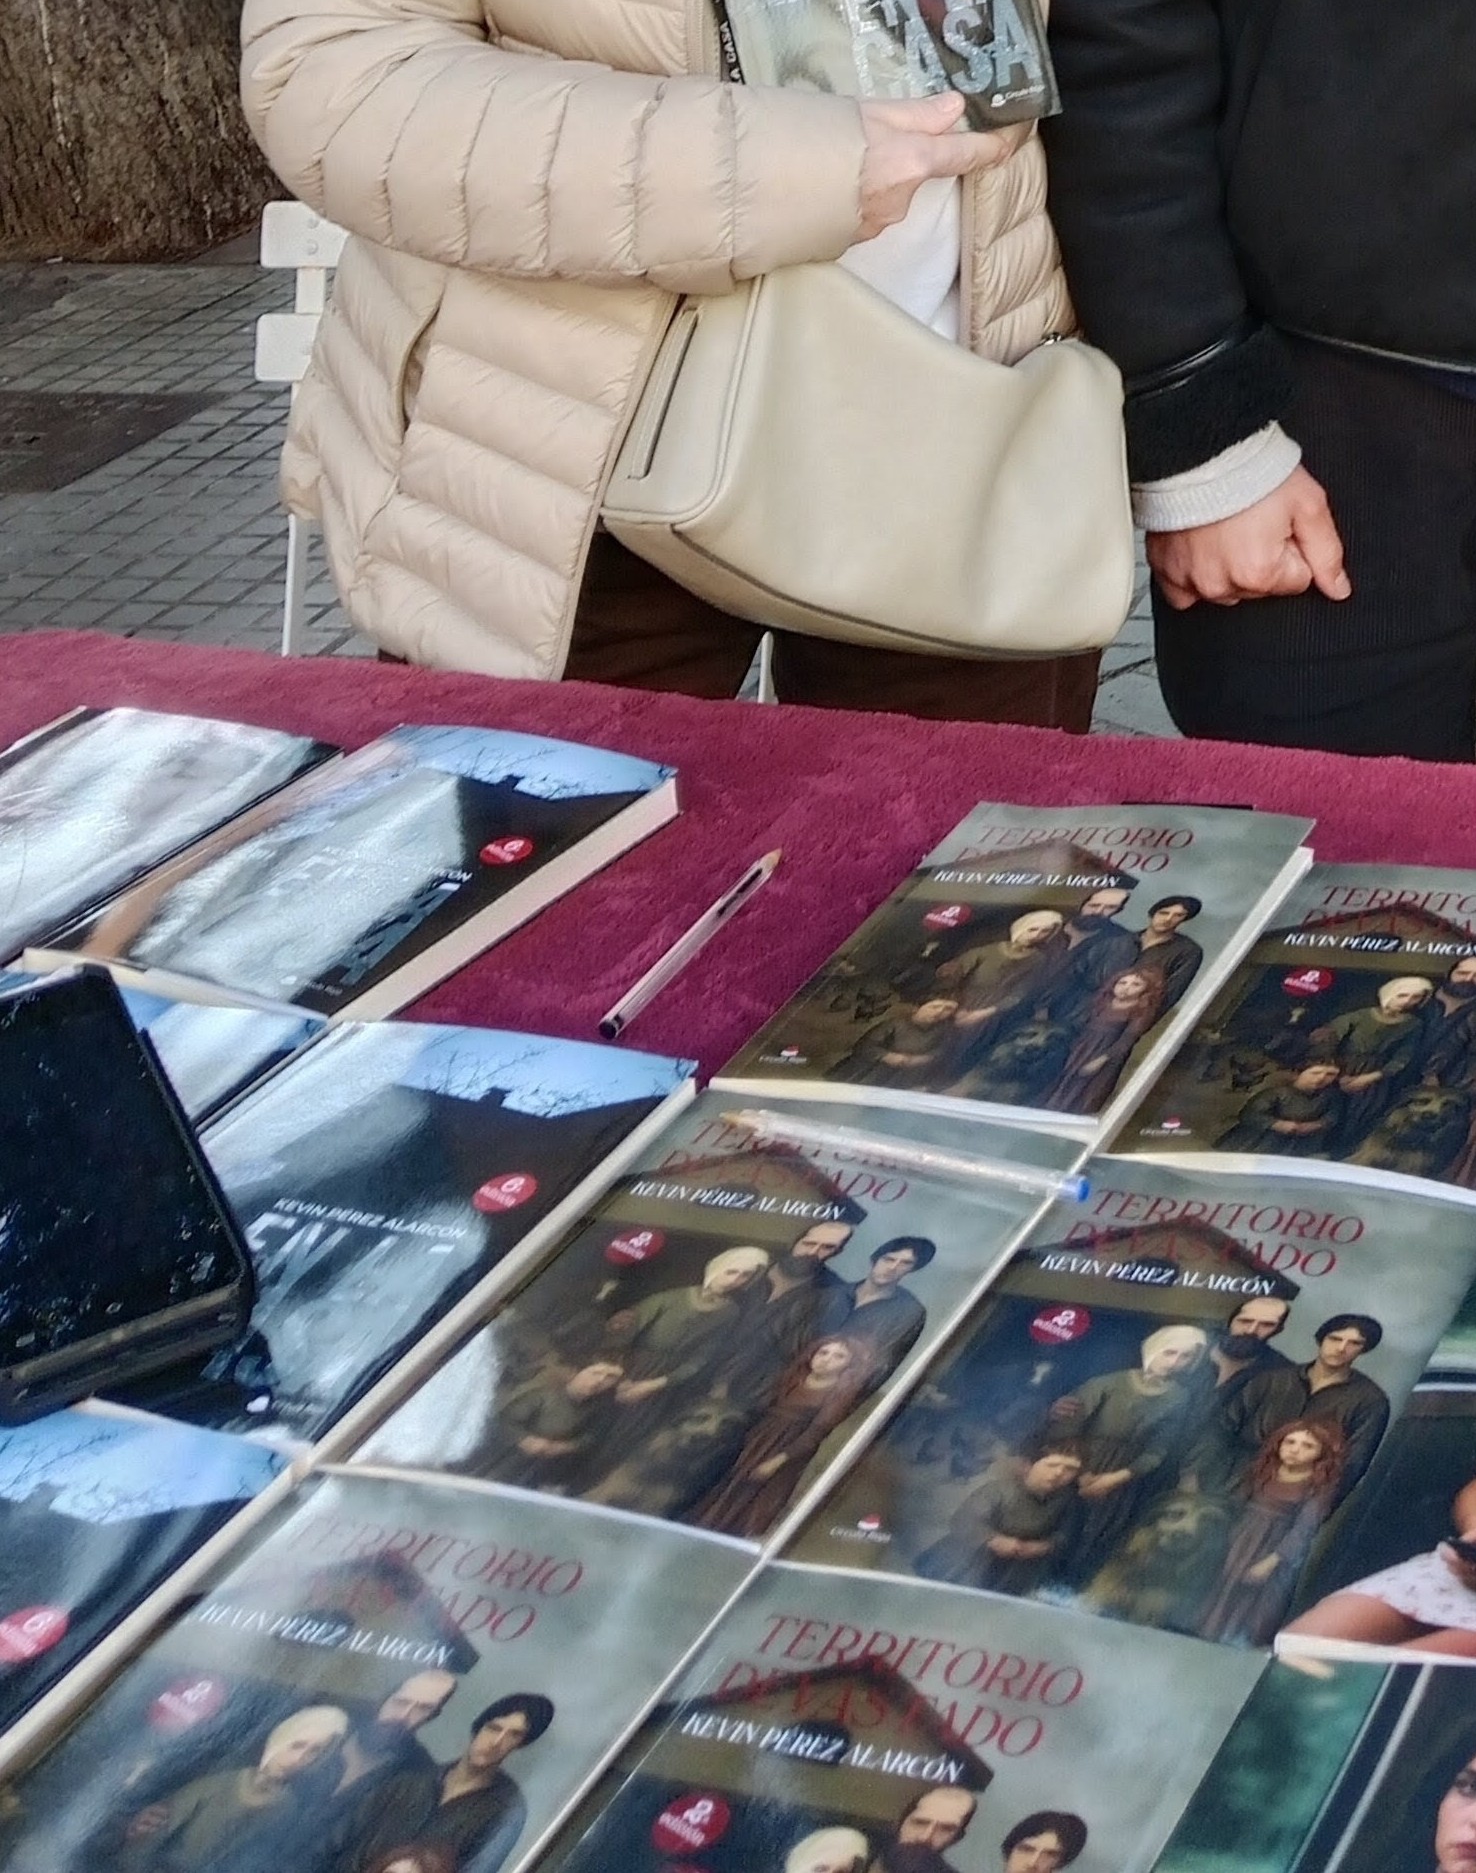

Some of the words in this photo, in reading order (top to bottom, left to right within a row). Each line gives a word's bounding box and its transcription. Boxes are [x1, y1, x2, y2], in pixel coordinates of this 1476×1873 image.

[935, 870, 985, 884] KEVIN
[985, 872, 1043, 886] PÉREZ
[1042, 873, 1119, 888] ALARCÓN
[1283, 932, 1338, 947] KEVIN
[1340, 935, 1400, 951] PÉREZ
[273, 1197, 327, 1217] KEVIN
[630, 1179, 690, 1201] KEVIN
[690, 1185, 755, 1208] PÉREZ
[751, 1195, 846, 1221] ALARCÓN
[1092, 1188, 1365, 1245] TERRITORIO
[1039, 1252, 1103, 1276] KEVIN
[1104, 1259, 1173, 1284] PÉREZ
[1172, 1270, 1277, 1297] ALARCÓN
[200, 1602, 271, 1631] KEVIN
[269, 1612, 349, 1647] PÉREZ
[342, 1626, 456, 1667] ALARCÓN
[756, 1613, 1084, 1708] TERRITORIO
[680, 1710, 759, 1749] KEVIN
[759, 1723, 845, 1766] PÉREZ
[839, 1740, 966, 1785] ALARCÓN
